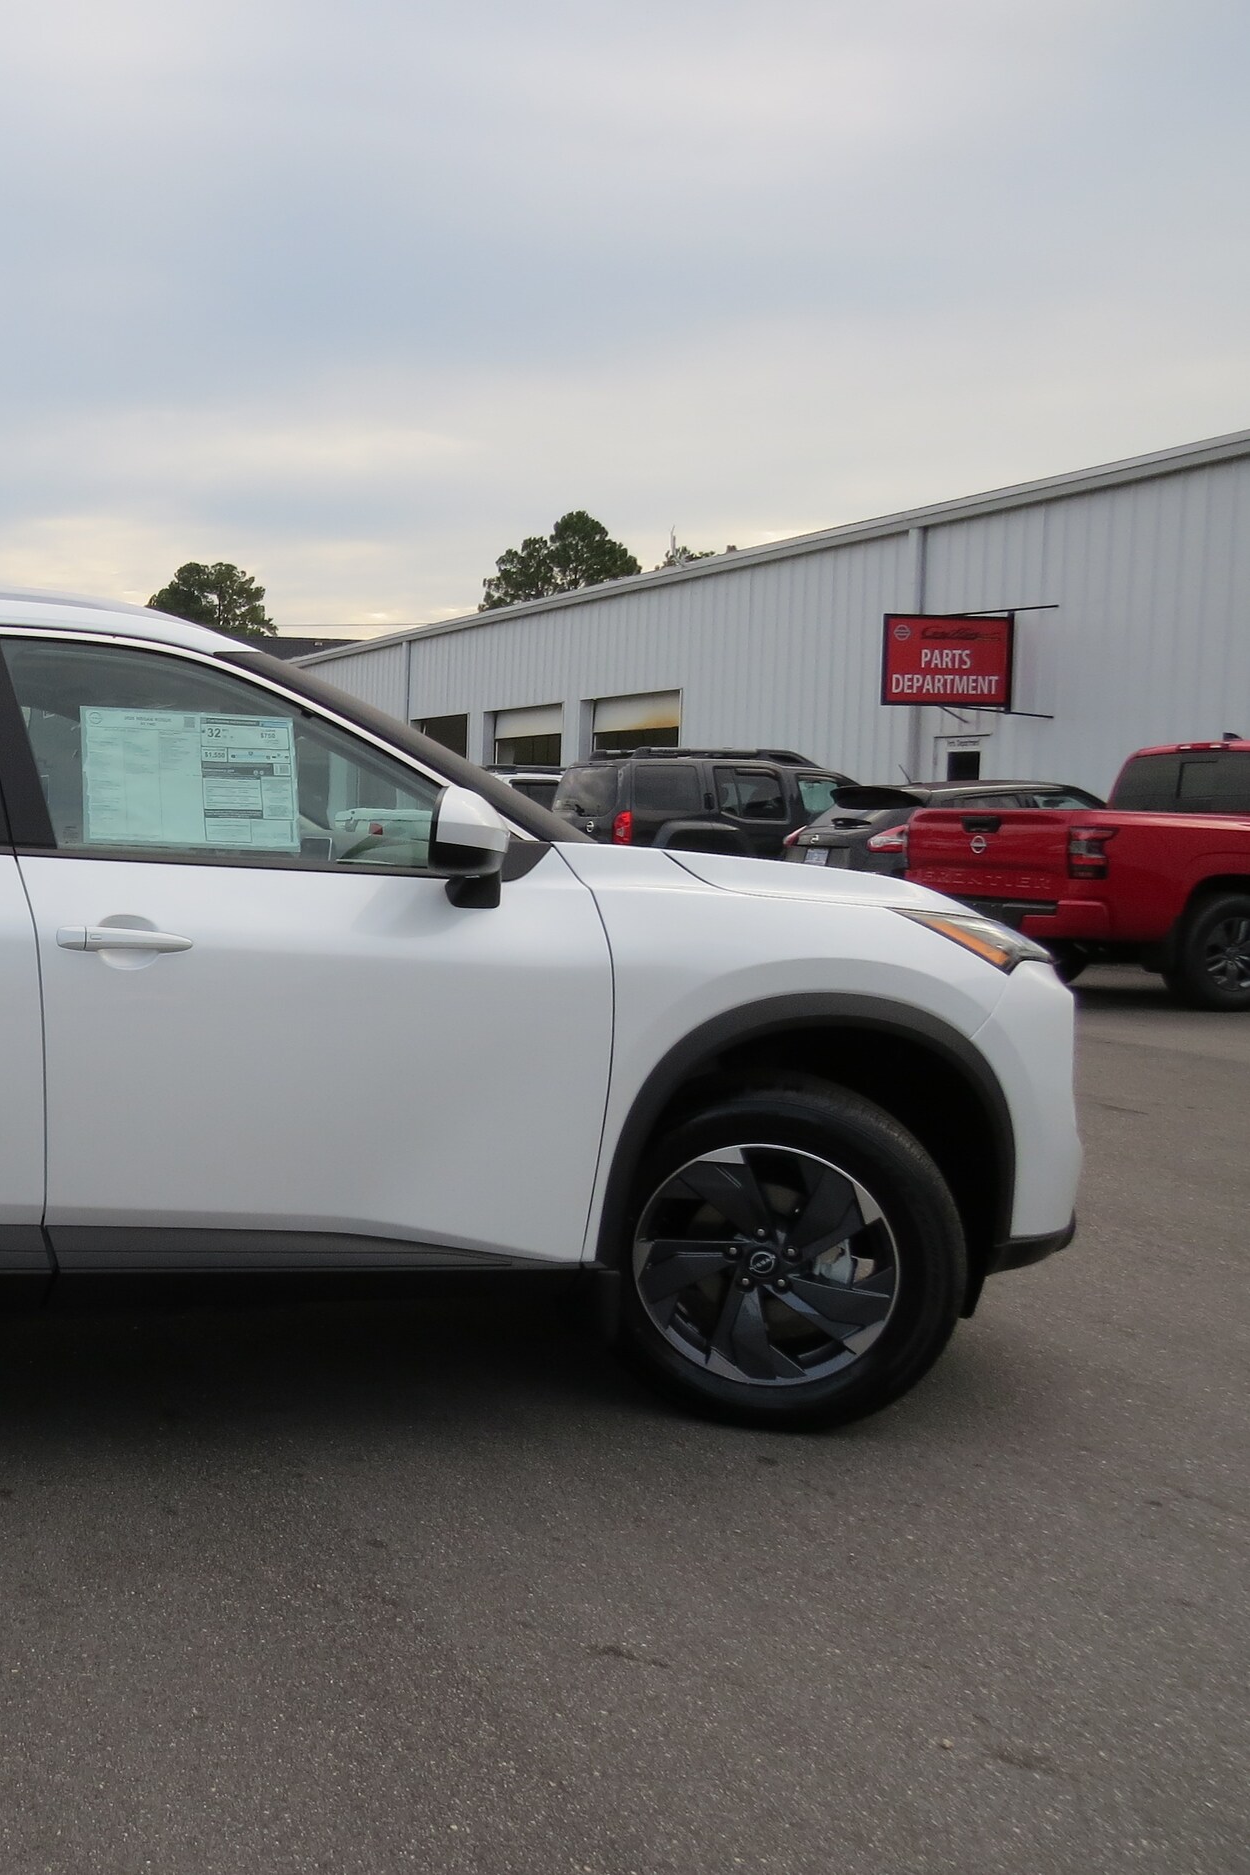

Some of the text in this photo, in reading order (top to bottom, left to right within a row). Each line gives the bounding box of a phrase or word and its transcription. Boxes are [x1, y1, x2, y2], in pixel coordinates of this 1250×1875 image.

[921, 649, 971, 669] PARTS
[892, 674, 999, 695] DEPARTMENT
[207, 728, 221, 738] 32
[922, 870, 1051, 890] FRONTIER
